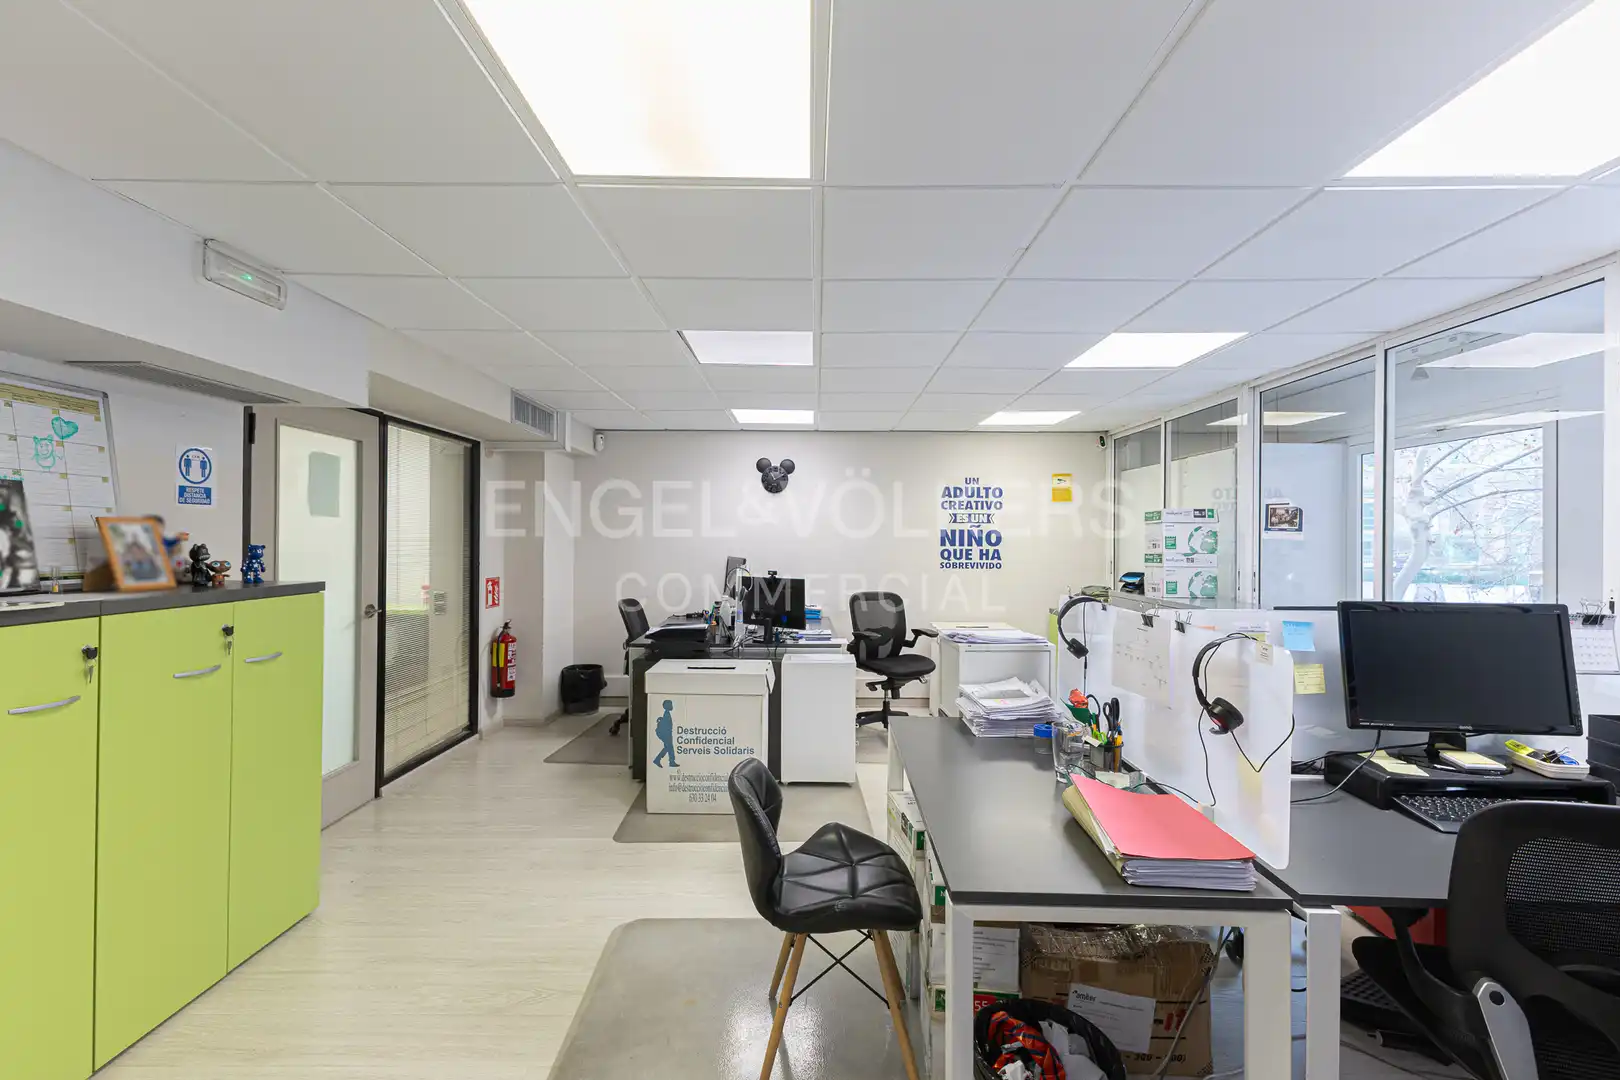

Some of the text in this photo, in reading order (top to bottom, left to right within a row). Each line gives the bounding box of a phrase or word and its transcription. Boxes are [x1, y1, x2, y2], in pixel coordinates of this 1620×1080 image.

[964, 477, 980, 485] UN
[941, 486, 1003, 498] ADULTO
[941, 500, 1003, 511] CREATIVO
[956, 513, 988, 522] ES UN
[940, 524, 1002, 547] NIÑO
[940, 548, 1002, 561] QUE HA
[940, 562, 1002, 570] SOBREVIVIDO
[676, 726, 727, 735] Destrucció
[676, 736, 735, 745] Confidencial
[676, 746, 755, 755] Serveis Solidaris
